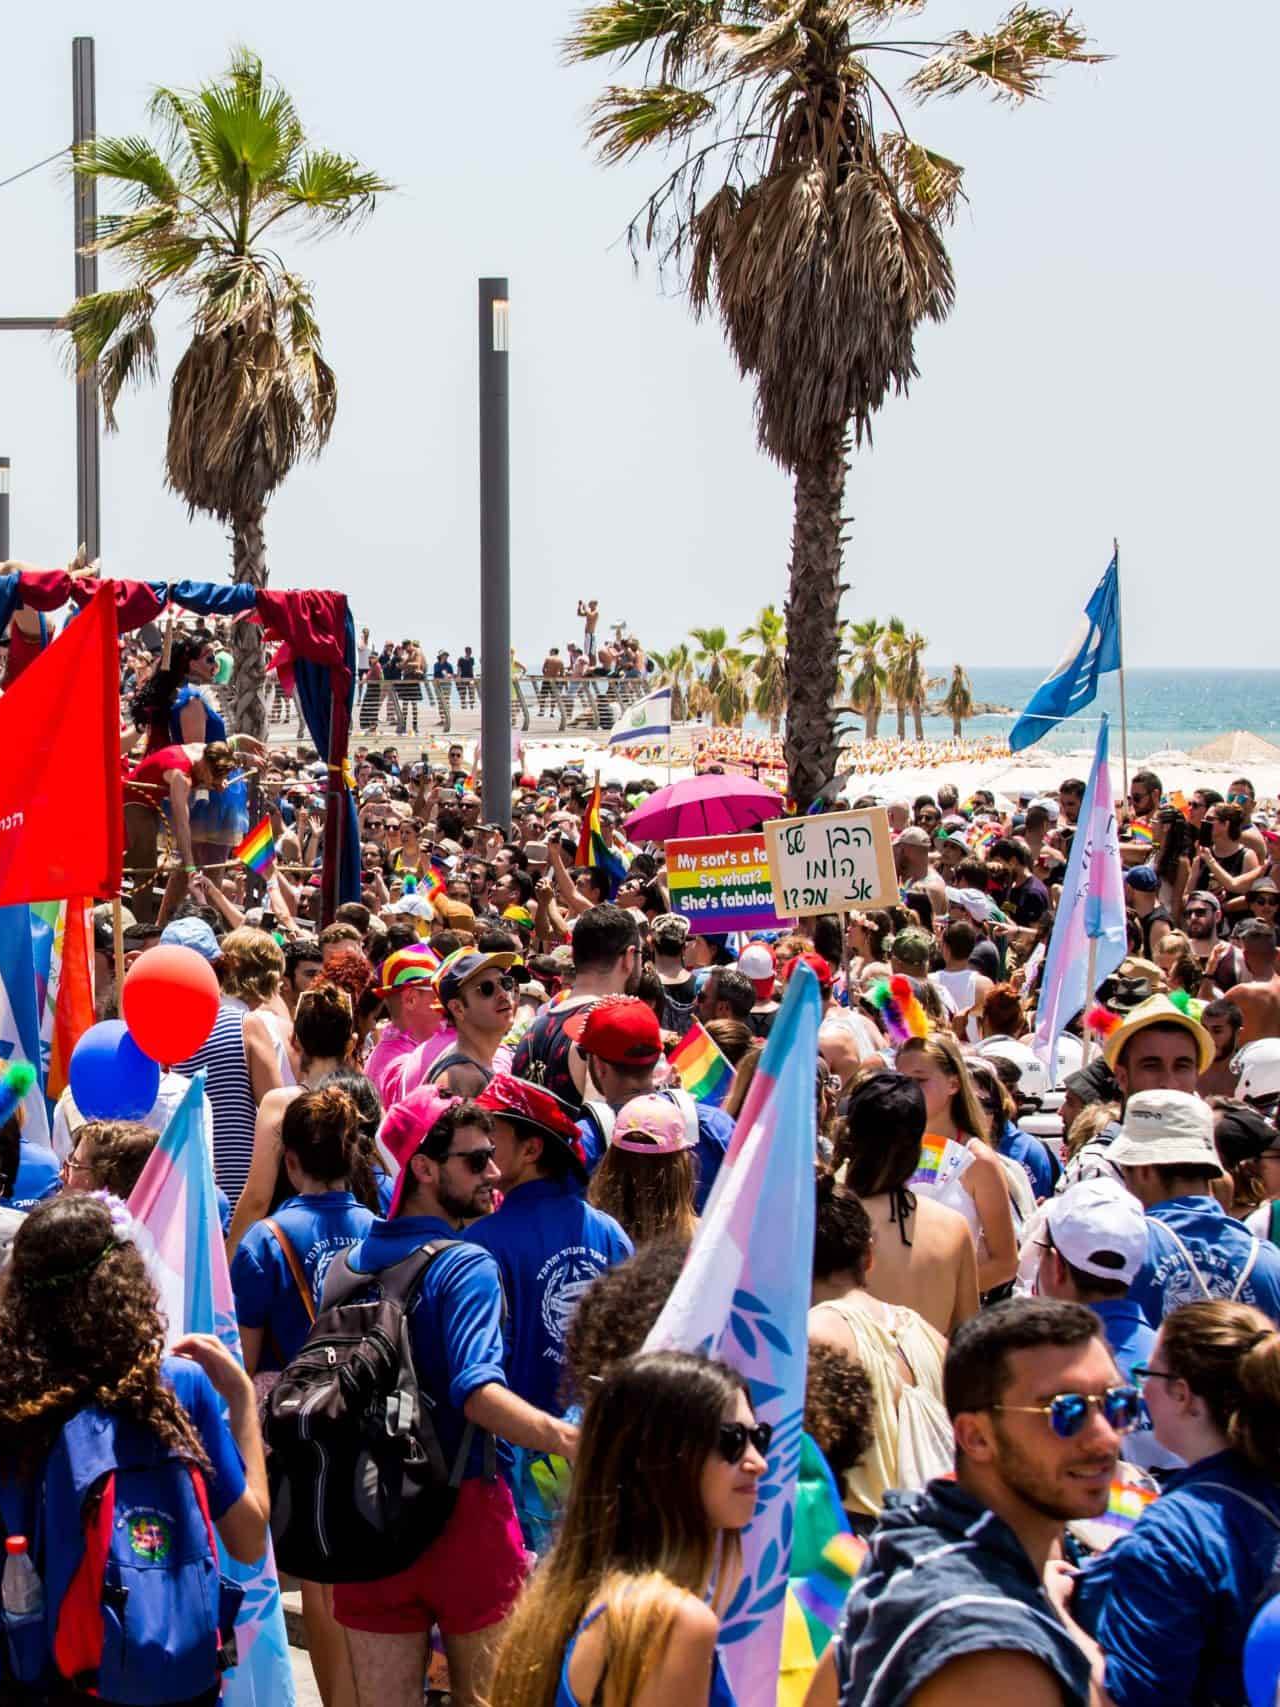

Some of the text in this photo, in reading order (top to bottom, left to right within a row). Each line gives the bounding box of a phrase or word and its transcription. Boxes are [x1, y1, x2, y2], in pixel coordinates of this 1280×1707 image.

[779, 823, 872, 858] הבן שלי
[677, 854, 697, 872] My
[701, 850, 737, 867] son's
[741, 852, 751, 864] a
[806, 858, 854, 880] הומו
[699, 870, 762, 889] So what?
[844, 878, 872, 901] אז
[680, 888, 774, 911] She's fabulou
